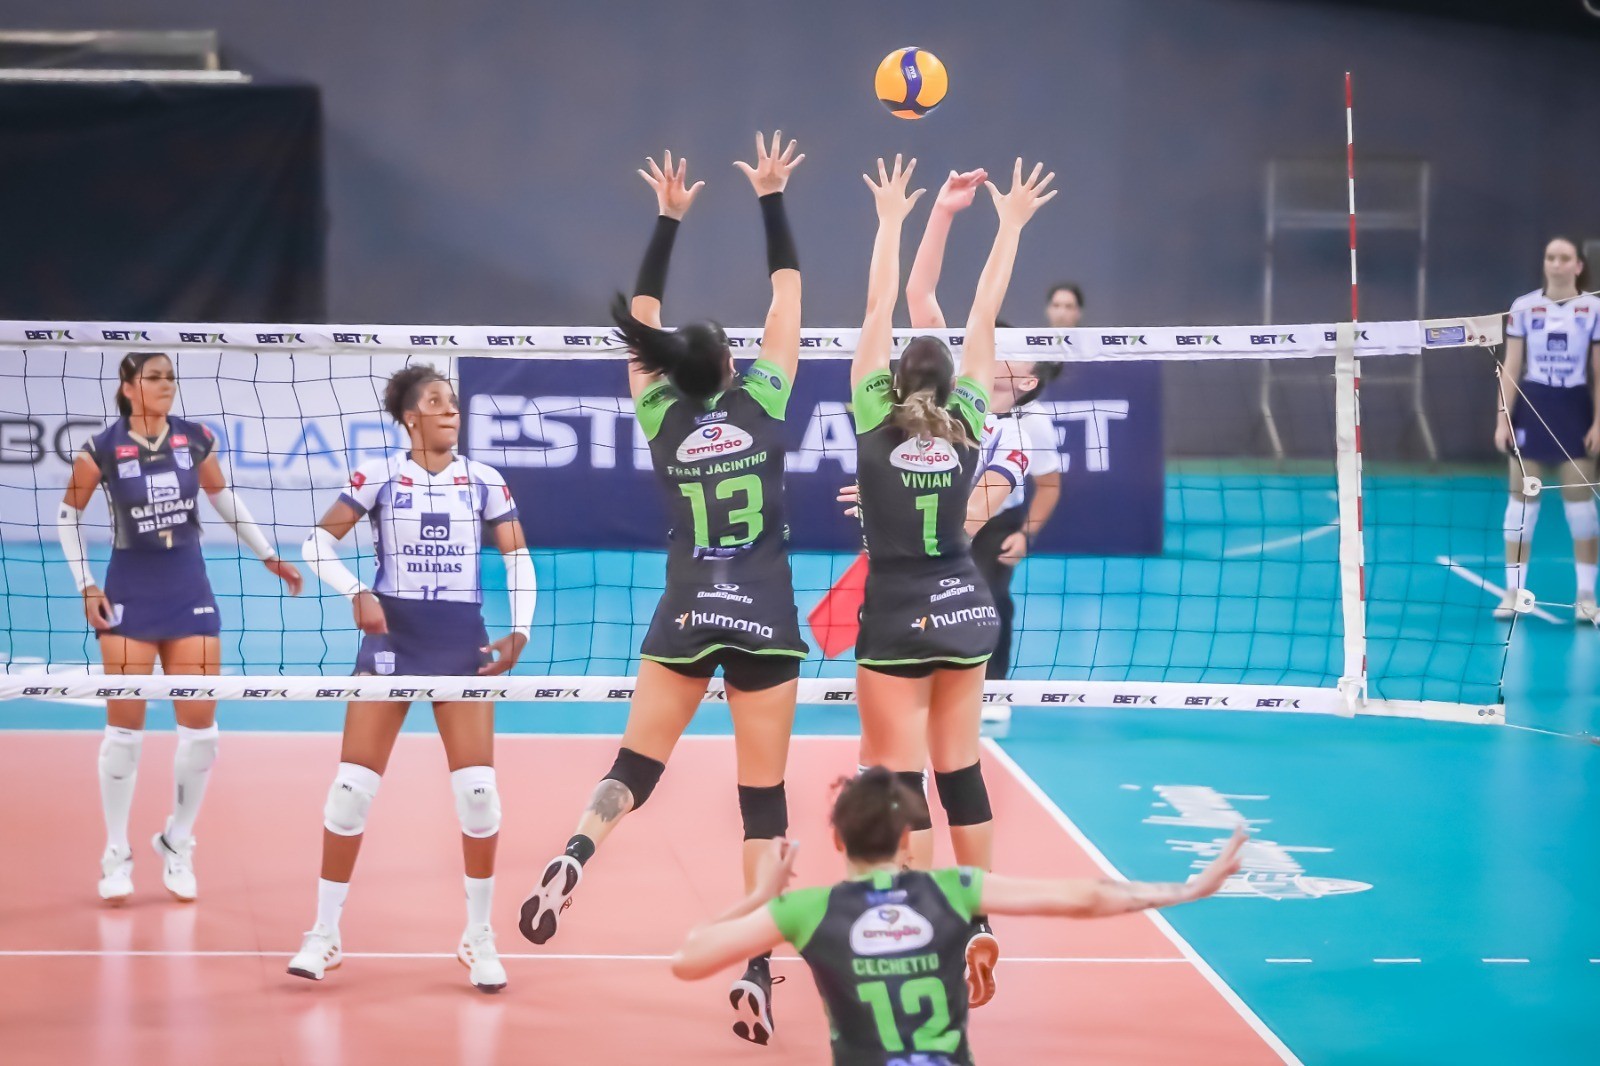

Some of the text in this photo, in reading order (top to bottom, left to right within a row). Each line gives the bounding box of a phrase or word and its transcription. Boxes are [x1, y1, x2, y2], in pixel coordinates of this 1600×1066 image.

[24, 330, 74, 340] BET7K
[101, 330, 151, 341] BET7K
[179, 332, 229, 343] BET7K
[256, 333, 305, 344] BET7K
[332, 333, 382, 344] BET7K
[409, 335, 459, 346] BET7K
[486, 335, 536, 346] BET7K
[563, 335, 611, 346] BET7K
[729, 337, 762, 347] ET7K
[1025, 335, 1073, 346] BET7K
[1101, 335, 1148, 346] BET7K
[1175, 335, 1222, 345] BET7K
[1250, 334, 1297, 345] BET7K
[686, 439, 742, 455] amigão
[705, 451, 767, 475] JACINTHO
[901, 472, 952, 489] VIVIAN
[131, 499, 195, 519] GERDAU
[678, 473, 764, 548] 13
[138, 511, 188, 533] minas
[915, 493, 941, 556] 1
[402, 544, 465, 557] GERDAU
[407, 559, 463, 573] minas
[691, 610, 773, 639] humana
[930, 605, 997, 629] humana
[22, 687, 68, 696] BET7K
[96, 688, 141, 697] BET7K
[169, 688, 215, 697] BET7K
[242, 688, 288, 698] BET7K
[315, 689, 361, 698] BET7K
[388, 689, 435, 698] BET7K
[461, 689, 507, 699] BET7K
[534, 688, 580, 699] BET7K
[607, 689, 634, 699] BET
[982, 693, 1014, 703] ET7K
[1041, 693, 1086, 703] BET7K
[1112, 694, 1158, 704] BET7K
[1184, 696, 1229, 706] BET7K
[1255, 698, 1301, 708] BET7K
[857, 976, 961, 1054] 12
